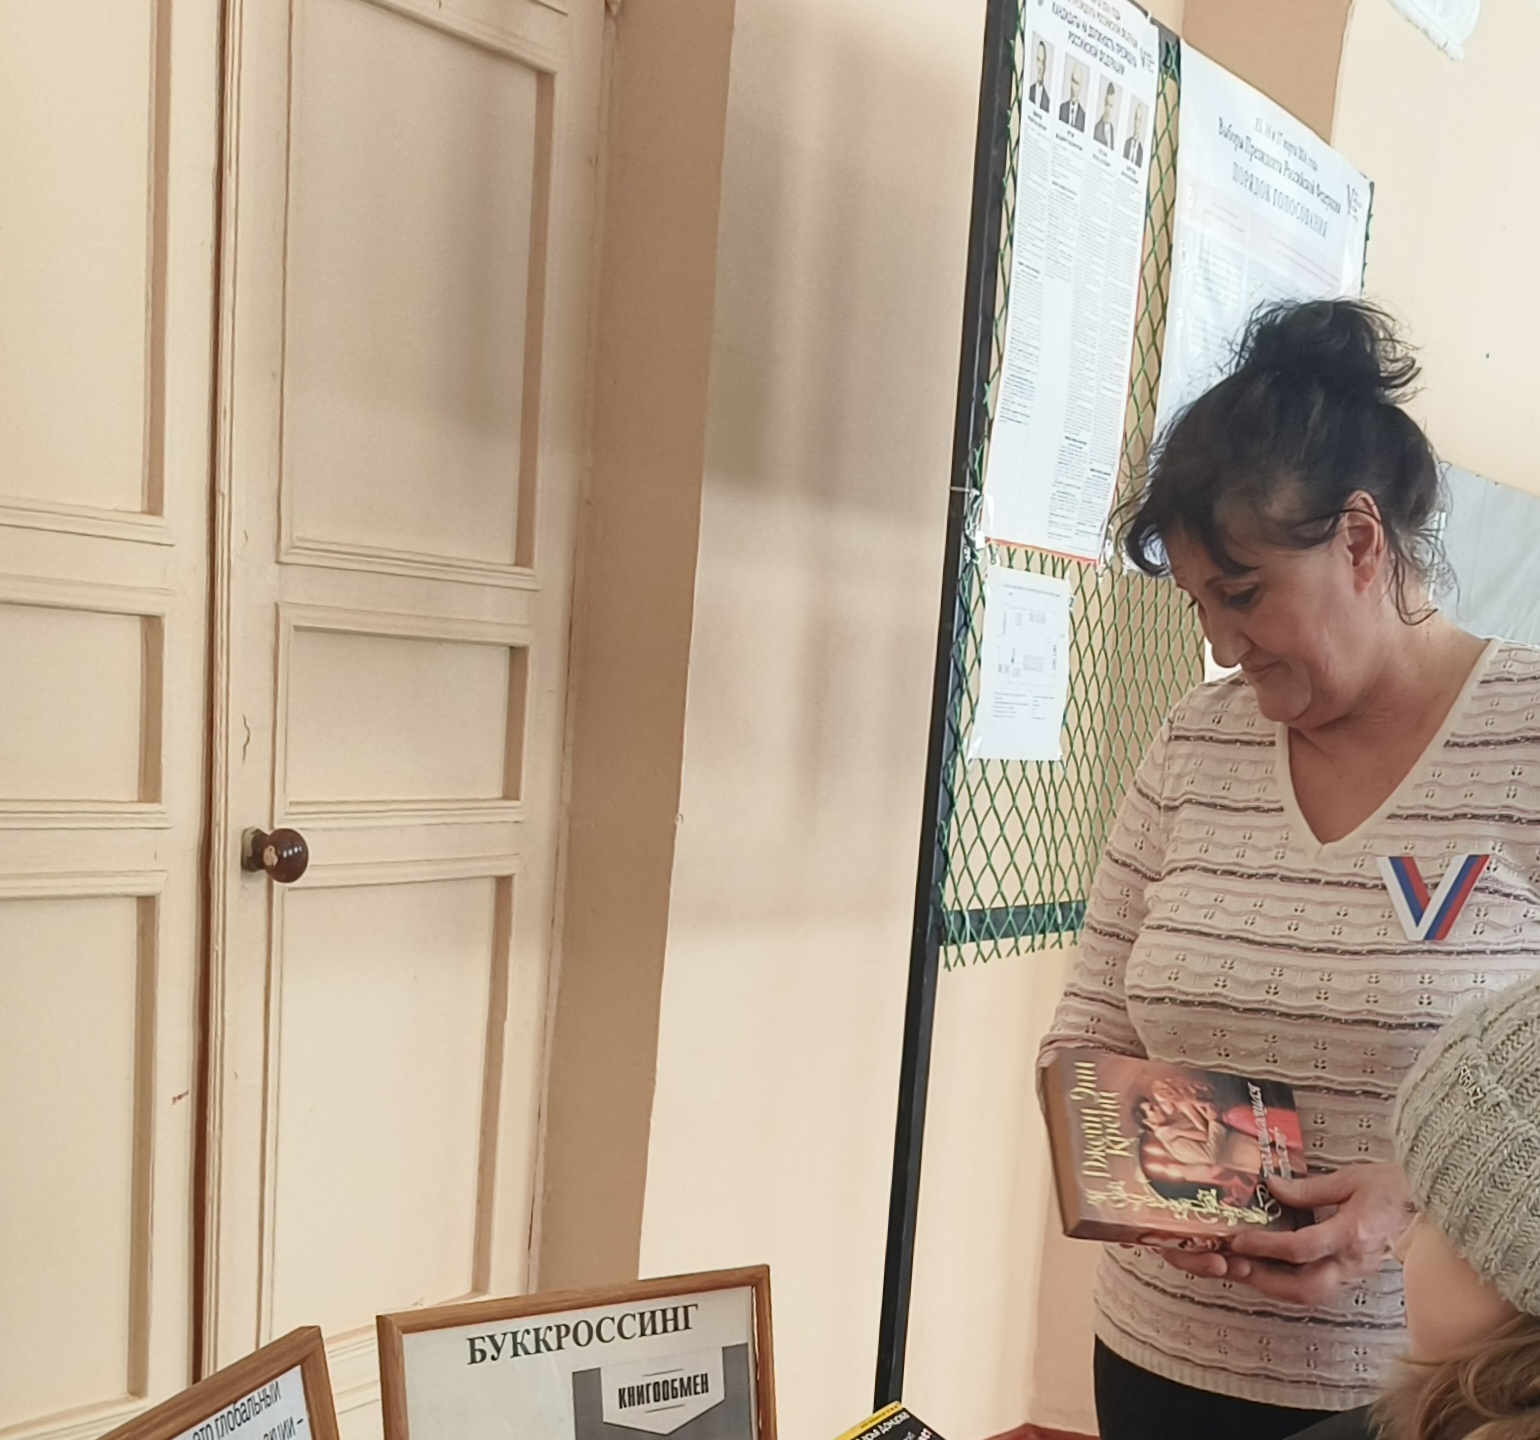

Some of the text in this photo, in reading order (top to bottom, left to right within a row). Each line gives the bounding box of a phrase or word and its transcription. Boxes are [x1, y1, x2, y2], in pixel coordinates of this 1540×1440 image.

[467, 1303, 698, 1365] БУККРОССИНГ
[214, 1380, 282, 1440] глобальный
[618, 1372, 709, 1409] КНИГООБМЕН
